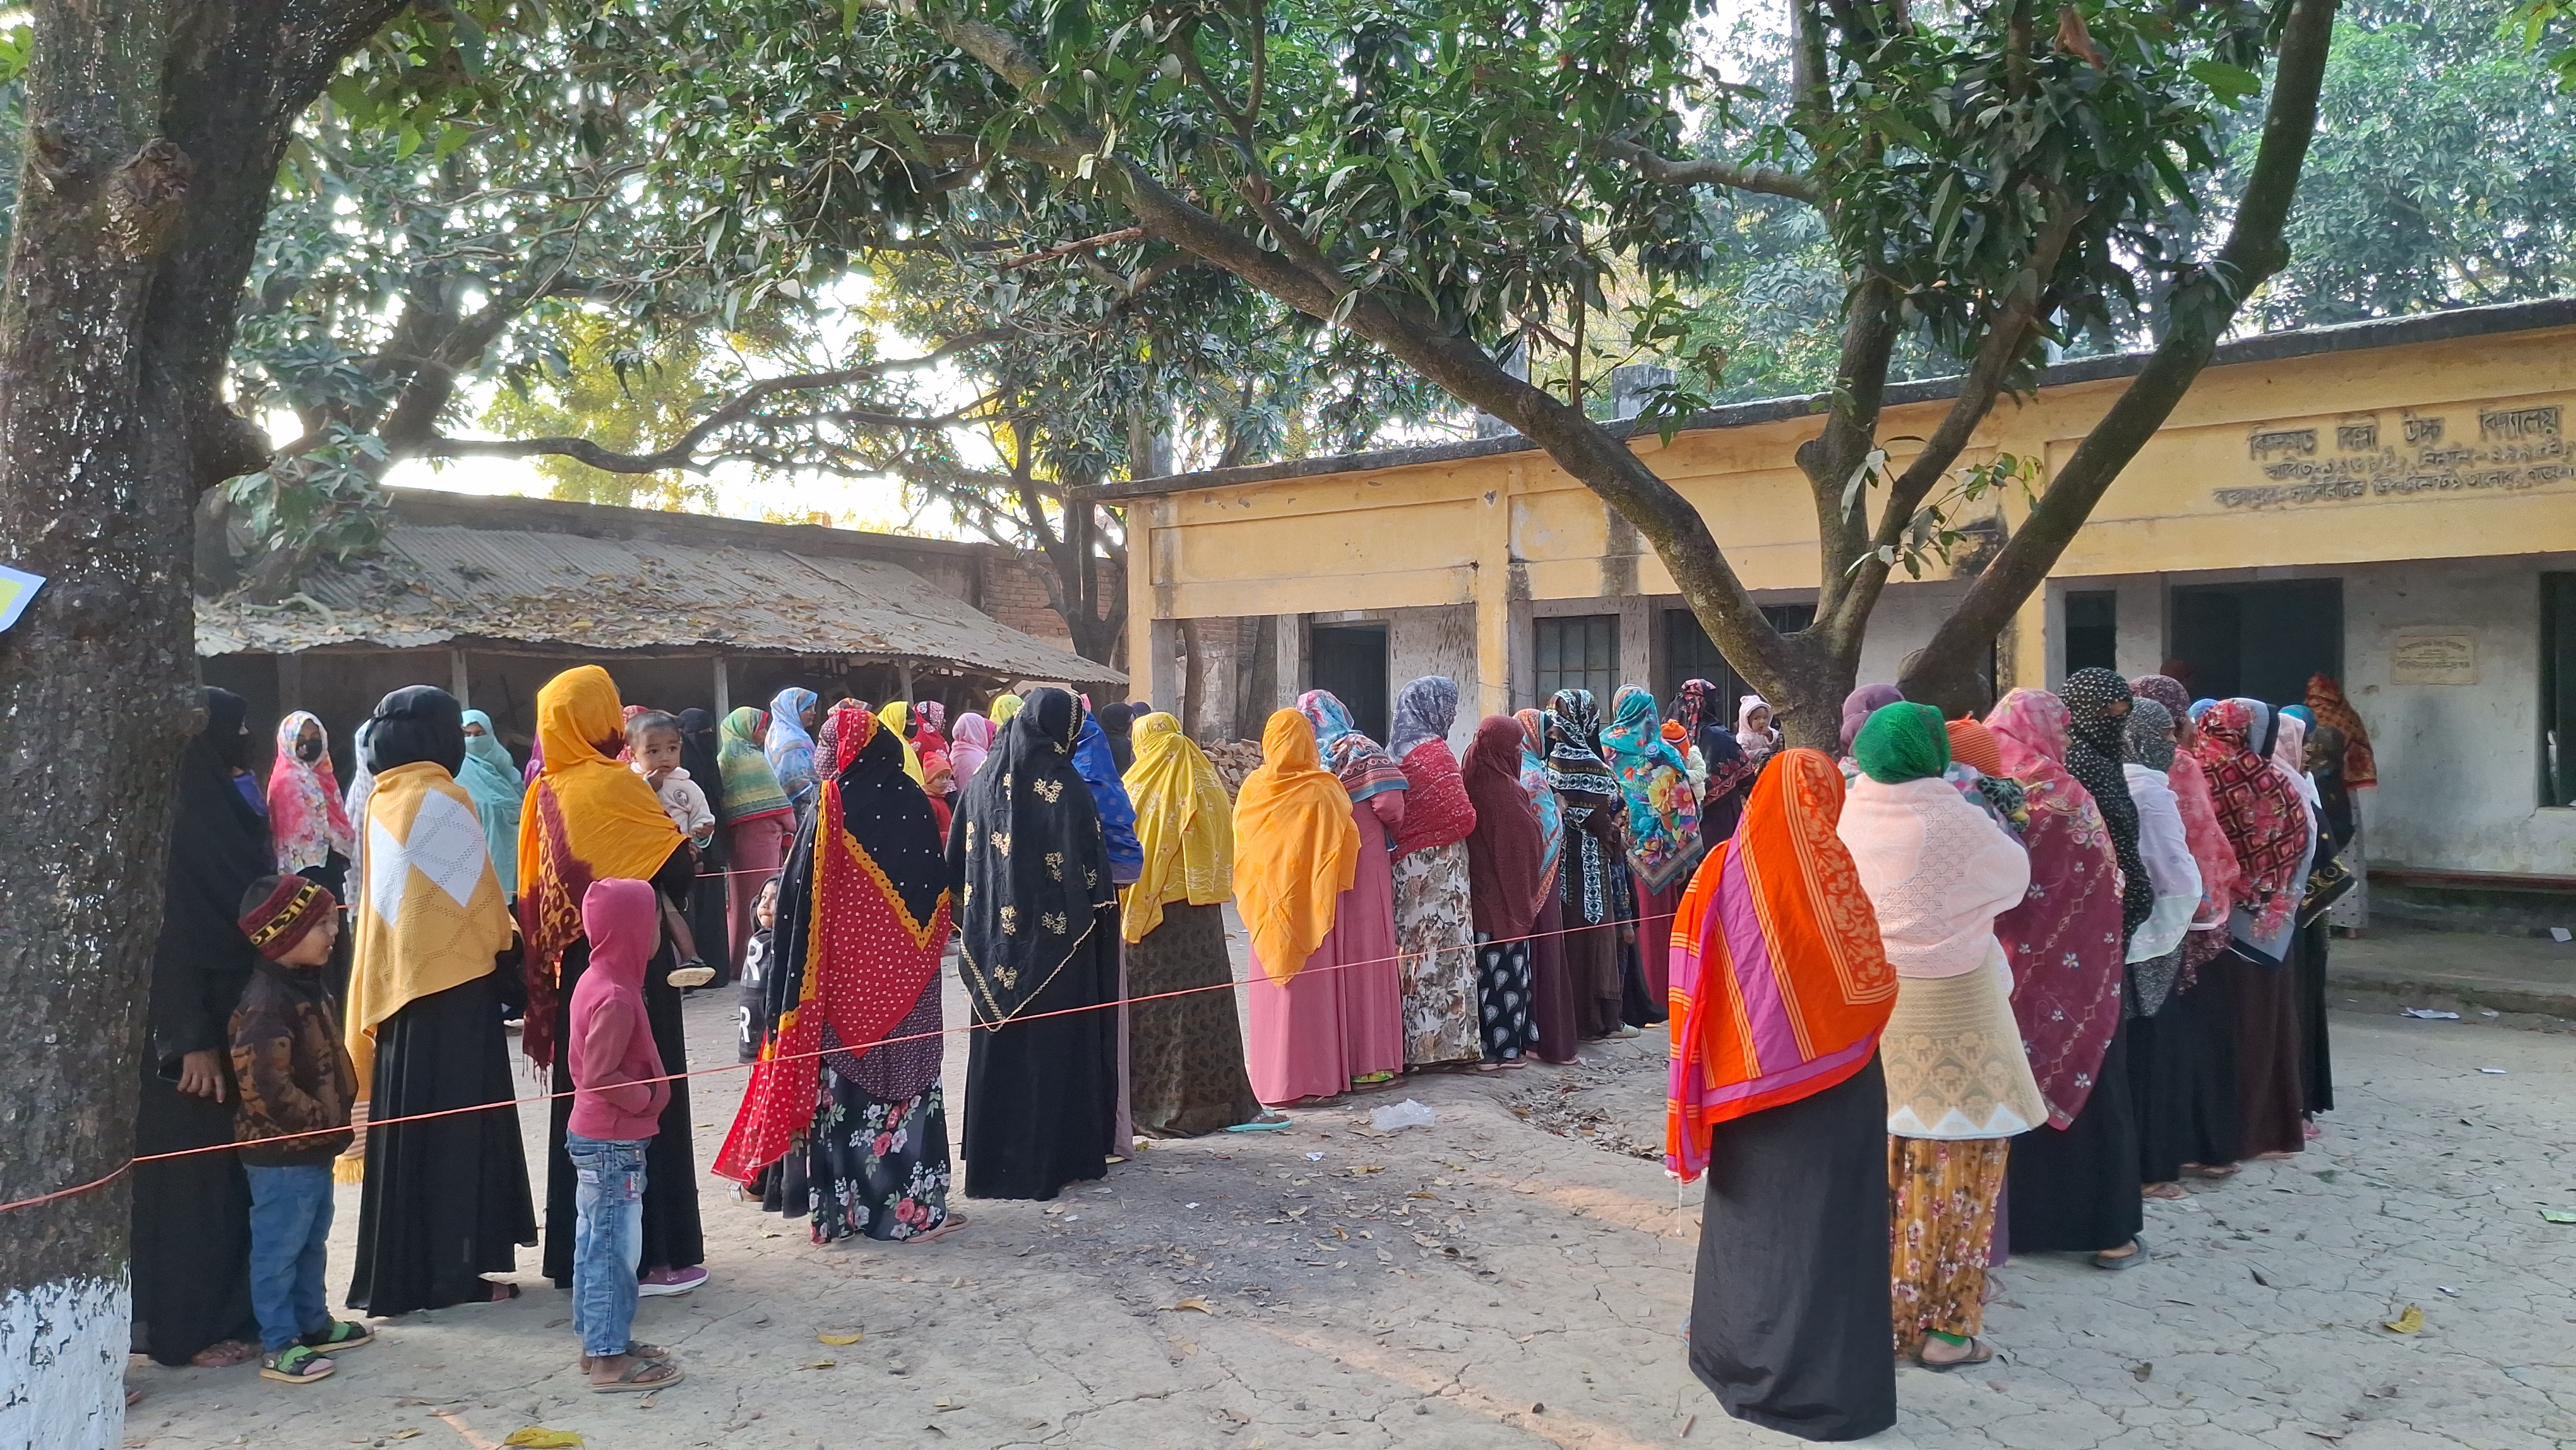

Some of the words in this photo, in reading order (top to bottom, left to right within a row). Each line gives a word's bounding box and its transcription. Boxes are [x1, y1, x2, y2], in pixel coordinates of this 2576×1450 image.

[2479, 405, 2562, 441] বিদ্যালয়
[744, 937, 763, 981] R
[739, 1005, 751, 1043] R
